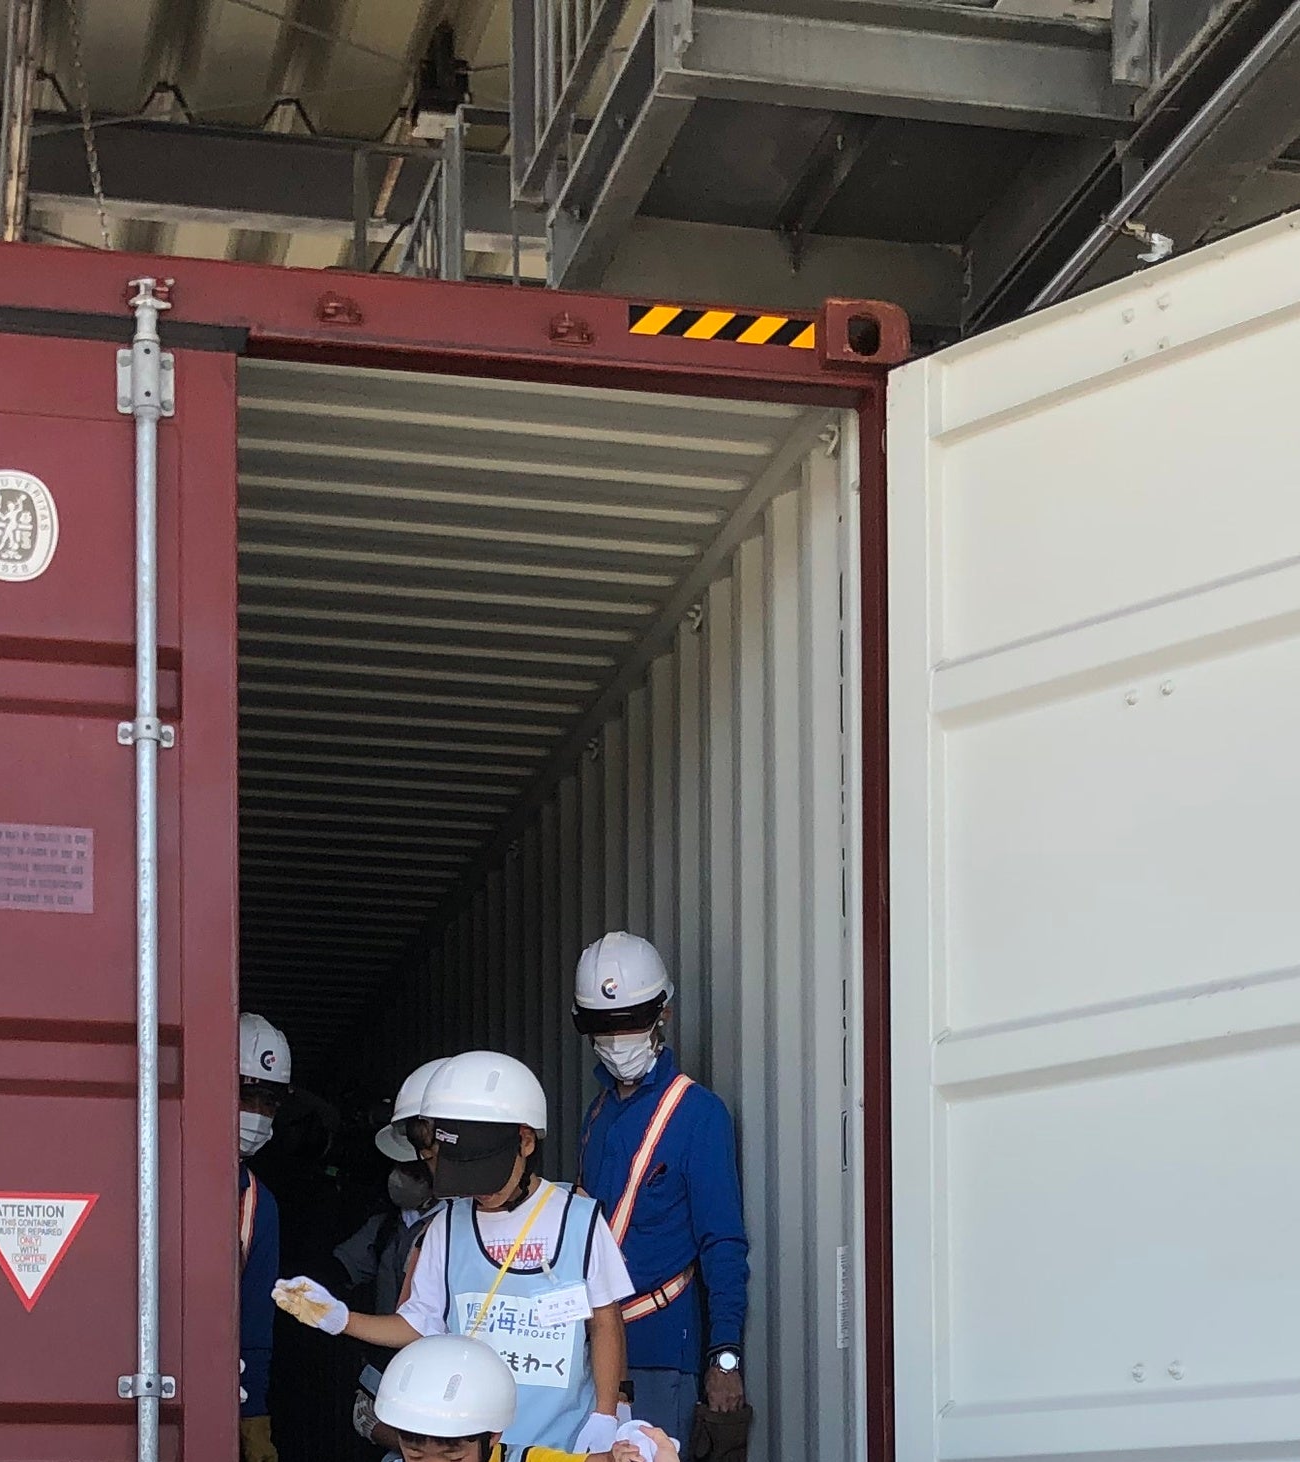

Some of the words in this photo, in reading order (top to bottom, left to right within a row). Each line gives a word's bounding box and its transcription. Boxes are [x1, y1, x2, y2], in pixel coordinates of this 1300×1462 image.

[16, 479, 49, 531] VERITAS
[18, 1219, 57, 1227] CONTAINER
[28, 1228, 62, 1236] REPAIRED
[20, 1246, 39, 1254] WITH
[17, 1264, 40, 1273] STEEL
[517, 1328, 566, 1340] PROJECT
